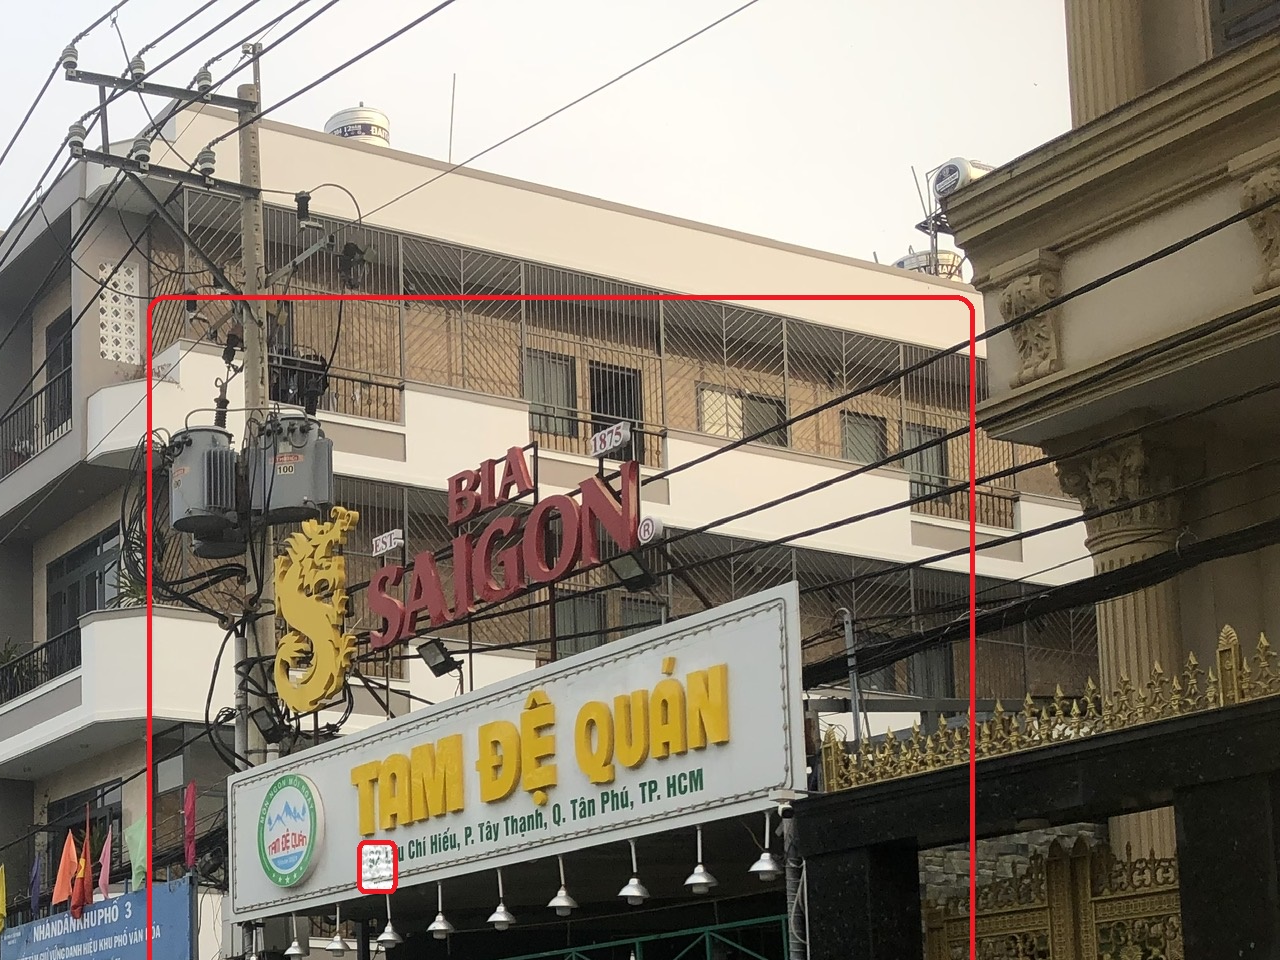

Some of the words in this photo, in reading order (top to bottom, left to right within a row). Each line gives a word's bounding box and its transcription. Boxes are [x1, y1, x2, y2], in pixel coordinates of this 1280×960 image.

[592, 426, 622, 453] 1875
[278, 465, 294, 474] 100
[447, 446, 535, 526] BIA
[368, 460, 640, 650] SAIGON
[350, 733, 465, 837] TAM
[475, 690, 558, 807] ĐỆ
[574, 656, 730, 785] QUÁN
[408, 835, 426, 861] Chí
[431, 827, 461, 856] Hiếu,
[464, 825, 474, 847] P.
[478, 819, 499, 842] Tây
[504, 808, 548, 838] Thạnh,
[552, 803, 566, 827] Q.
[570, 795, 596, 819] Tân
[601, 786, 634, 811] Phú,
[639, 782, 660, 804] TP.
[666, 768, 704, 798] HCM
[98, 897, 119, 926] PHỐ
[125, 901, 132, 919] 3
[99, 937, 113, 951] KHU
[114, 926, 128, 948] PHỐ
